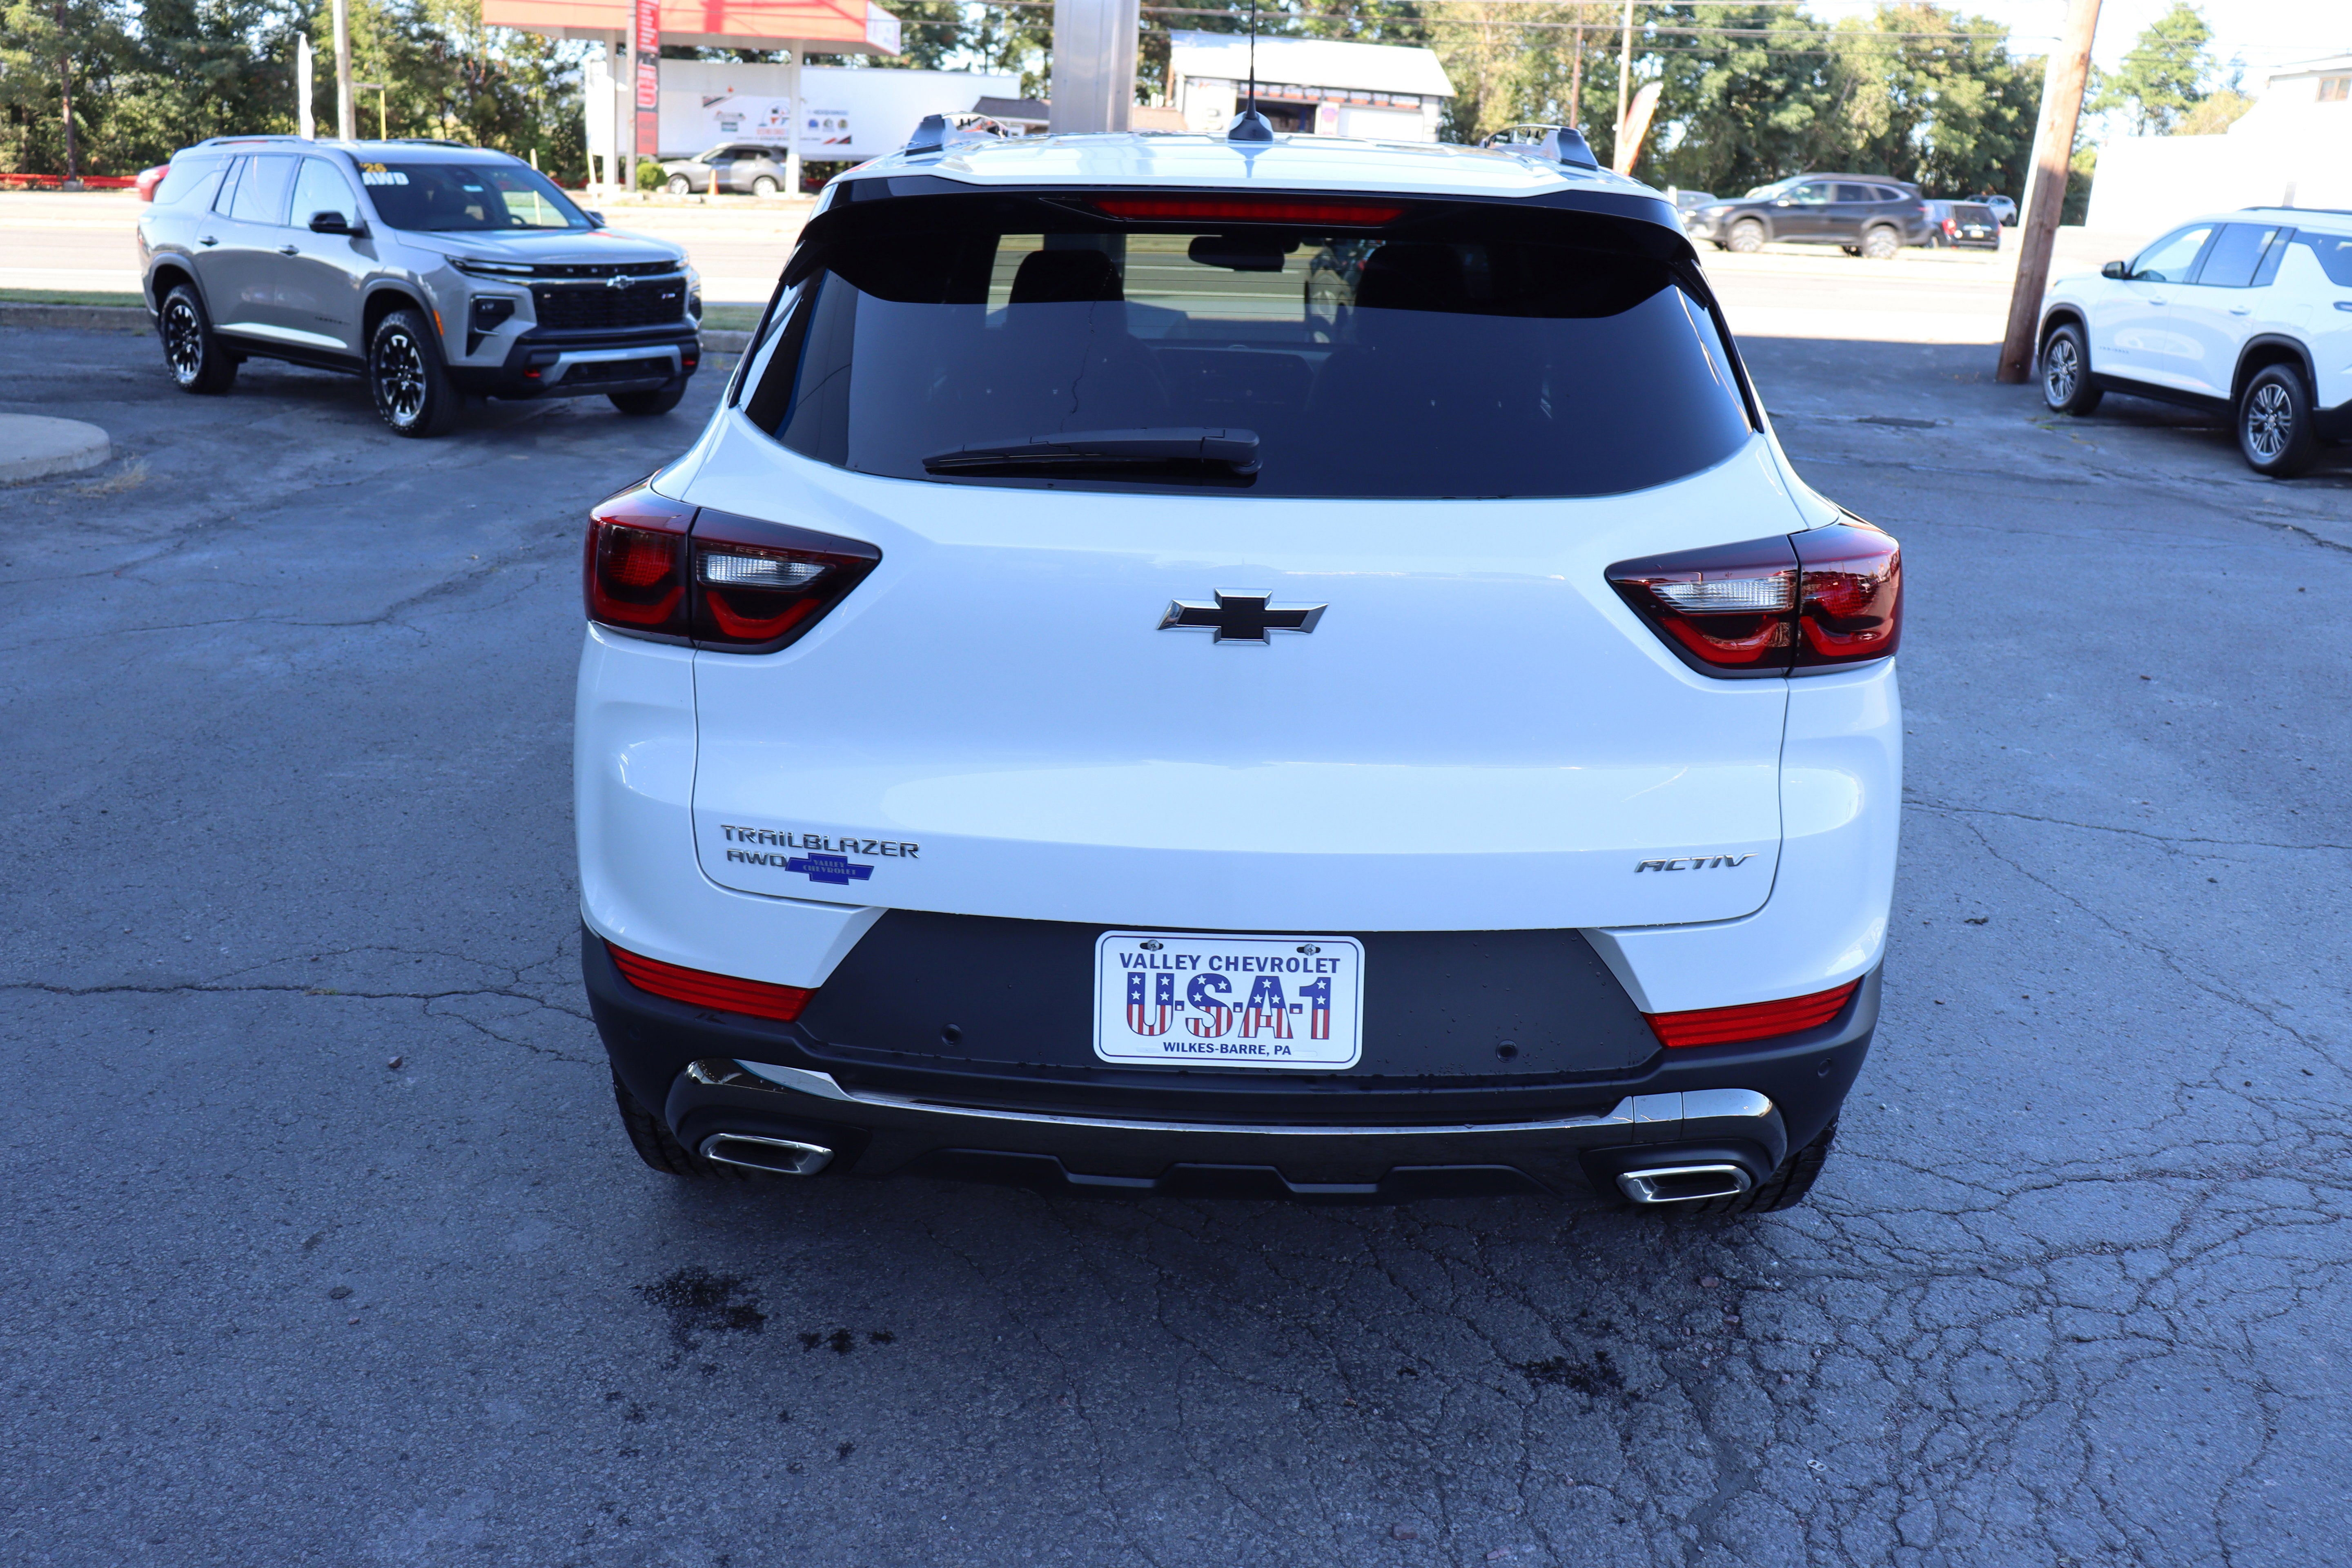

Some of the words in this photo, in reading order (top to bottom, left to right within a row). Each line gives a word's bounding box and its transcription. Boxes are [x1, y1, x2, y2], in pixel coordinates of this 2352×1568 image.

[362, 172, 410, 185] AWD
[721, 825, 920, 858] TRAILBLAZER
[727, 849, 787, 867] AWD
[813, 859, 844, 868] VALLEY
[1634, 852, 1759, 873] ACTIV
[802, 865, 856, 875] CHEVROLET
[1119, 953, 1201, 971] VALLEY
[1209, 956, 1341, 973] CHEVROLET
[1163, 1042, 1270, 1057] WILKES-BARRE,
[1274, 1044, 1292, 1056] PA
